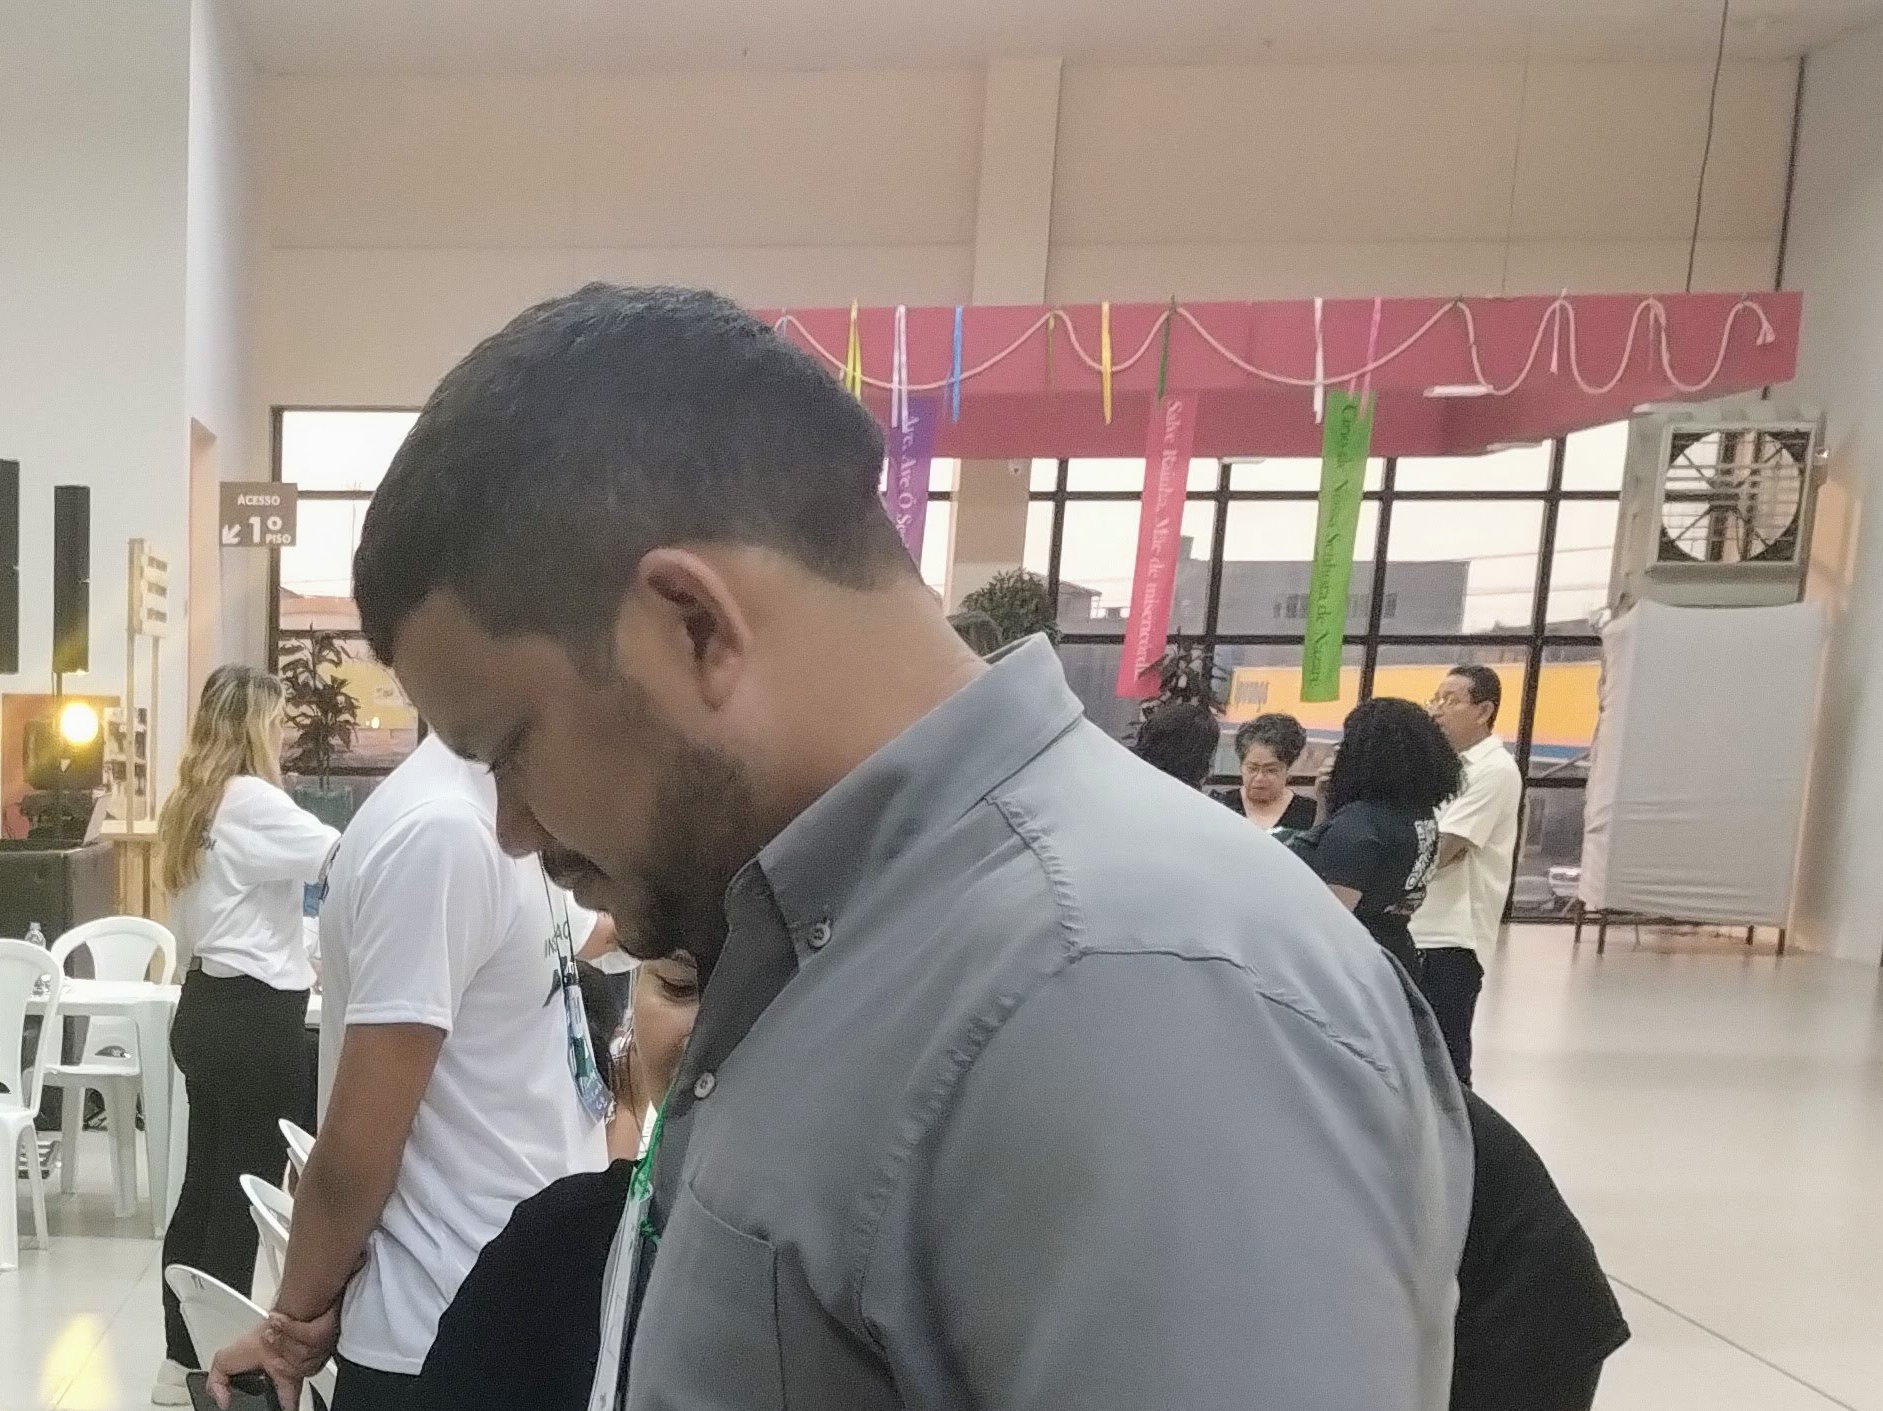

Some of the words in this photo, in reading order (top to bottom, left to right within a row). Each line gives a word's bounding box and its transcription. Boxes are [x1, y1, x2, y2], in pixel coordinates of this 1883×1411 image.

[237, 493, 281, 506] ACESSO
[265, 533, 292, 544] PISO
[1147, 557, 1163, 579] de
